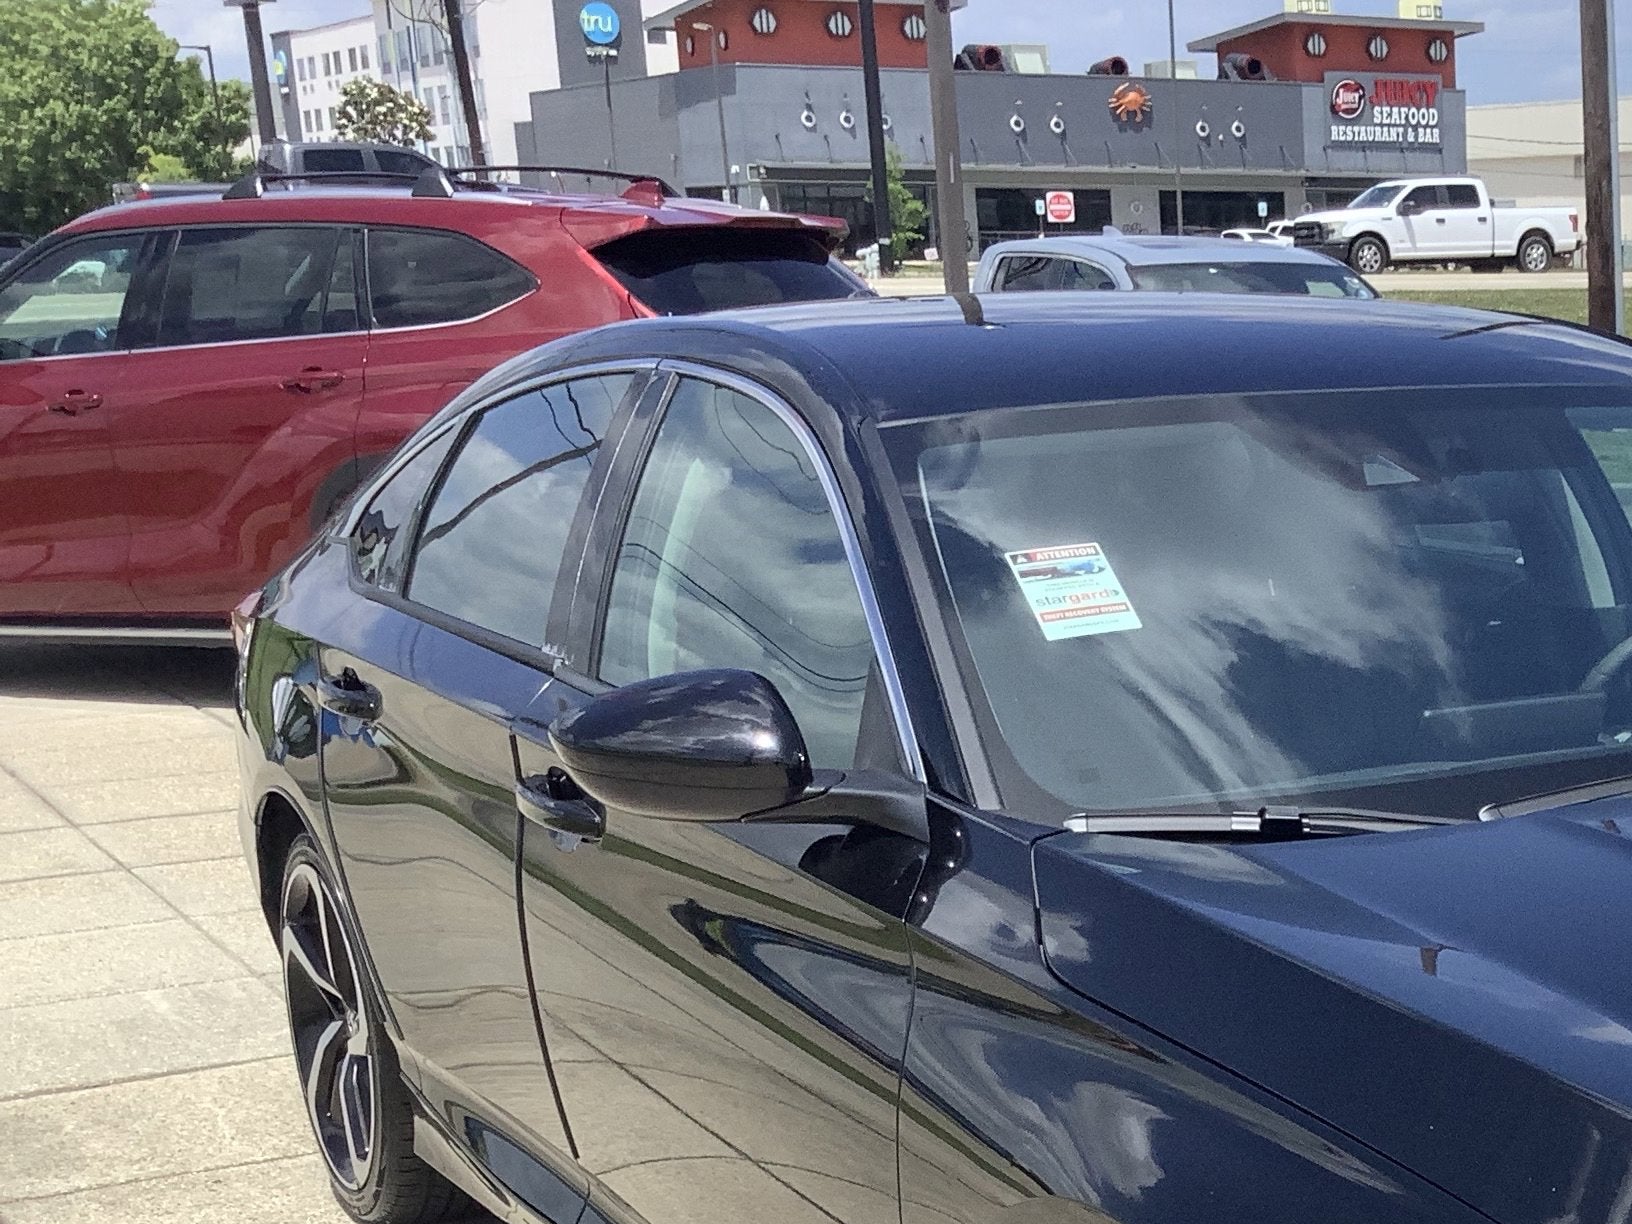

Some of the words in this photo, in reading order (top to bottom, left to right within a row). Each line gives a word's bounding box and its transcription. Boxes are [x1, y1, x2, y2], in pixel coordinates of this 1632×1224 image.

[580, 9, 612, 32] tru
[1373, 106, 1439, 126] SEAFOOD
[1330, 125, 1404, 142] RESTAURANT
[1407, 128, 1415, 143] &
[1418, 127, 1440, 143] BAR
[1036, 546, 1096, 561] ATTENTION
